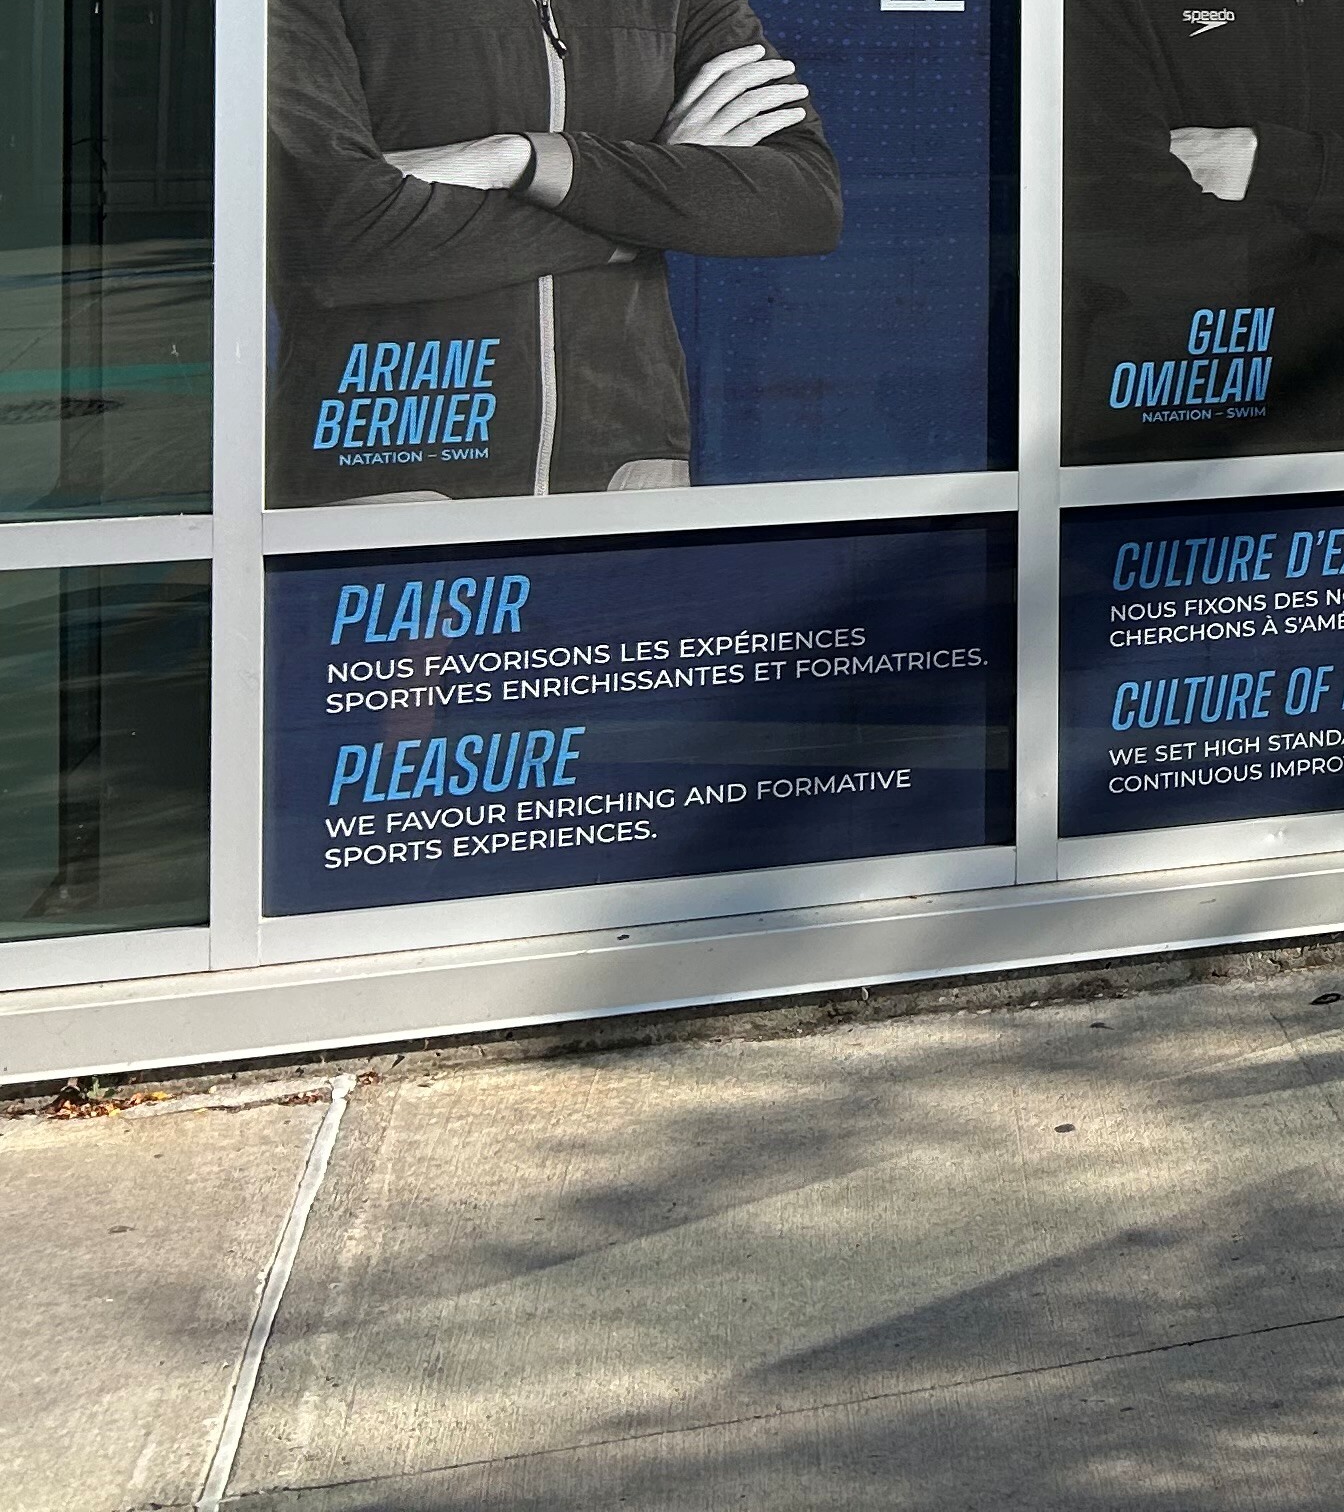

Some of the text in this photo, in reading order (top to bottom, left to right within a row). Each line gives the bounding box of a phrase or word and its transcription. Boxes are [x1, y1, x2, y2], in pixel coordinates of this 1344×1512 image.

[1182, 8, 1236, 23] speedo
[1188, 308, 1275, 355] GLEN
[339, 338, 500, 392] ARIANE
[1109, 357, 1272, 409] OMIELAN
[313, 394, 496, 449] BERNIER
[1142, 408, 1211, 422] NATATION
[1226, 406, 1265, 418] SWIM
[339, 451, 422, 465] NATATION
[441, 447, 488, 460] SWIM
[1113, 534, 1277, 591] CULTURE
[331, 575, 530, 645] PLAISIR
[1109, 620, 1255, 647] CHERCHONS
[1261, 614, 1278, 635] À
[1111, 601, 1176, 621] NOUS
[1184, 594, 1266, 616] FIXONS
[1274, 590, 1318, 609] DES
[325, 648, 987, 713] SPORTIVES ENRICHISSANTES ET FORMATRICES.
[327, 627, 865, 683] NOUS FAVORISONS LES EXPÉRIENCES
[1111, 670, 1276, 731] CULTURE
[1284, 666, 1333, 716] OF
[328, 726, 586, 806] PLEASURE
[1108, 746, 1147, 765] WE
[1154, 741, 1196, 761] SET
[1204, 736, 1259, 757] HIGH
[325, 768, 910, 837] WE FAVOUR ENRICHING AND FORMATIVE
[1109, 763, 1262, 793] CONTINUOUS
[324, 820, 657, 868] SPORTS EXPERIENCES.
